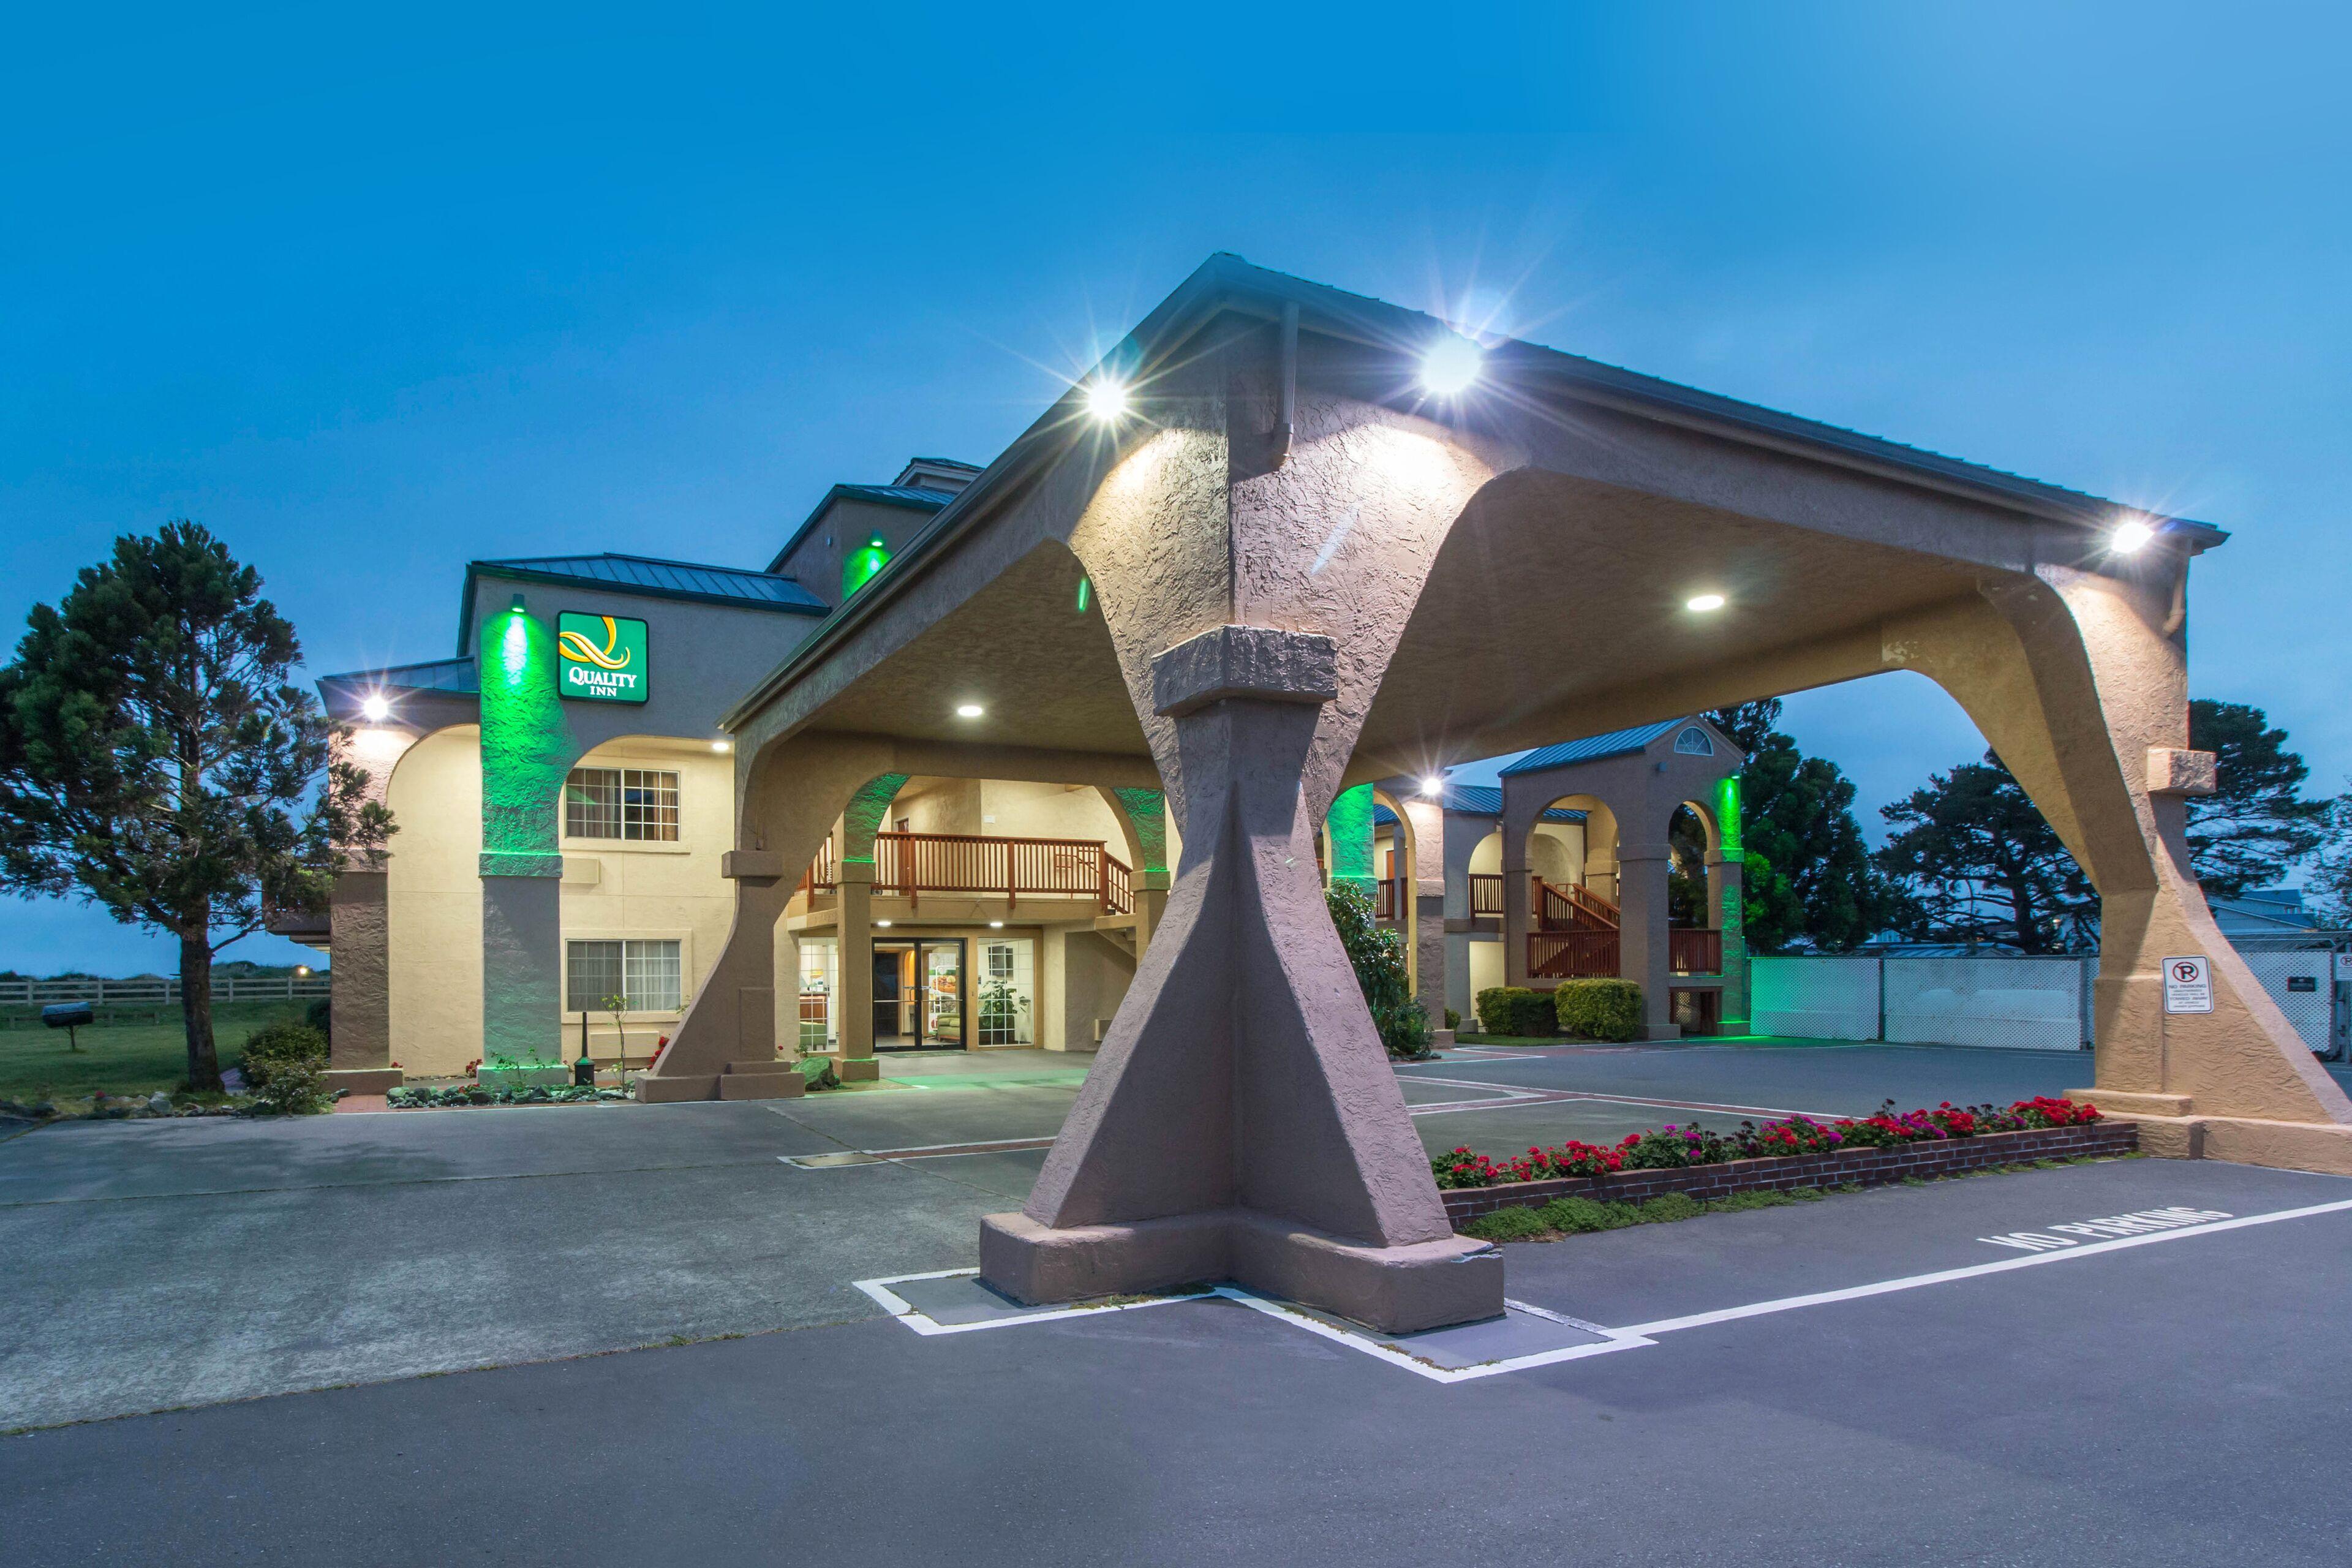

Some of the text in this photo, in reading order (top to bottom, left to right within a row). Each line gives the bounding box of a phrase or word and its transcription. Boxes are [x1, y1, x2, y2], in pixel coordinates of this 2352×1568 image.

[569, 666, 637, 688] QUALITY
[590, 685, 617, 697] INN
[1975, 1206, 2234, 1251] NO PARKING
